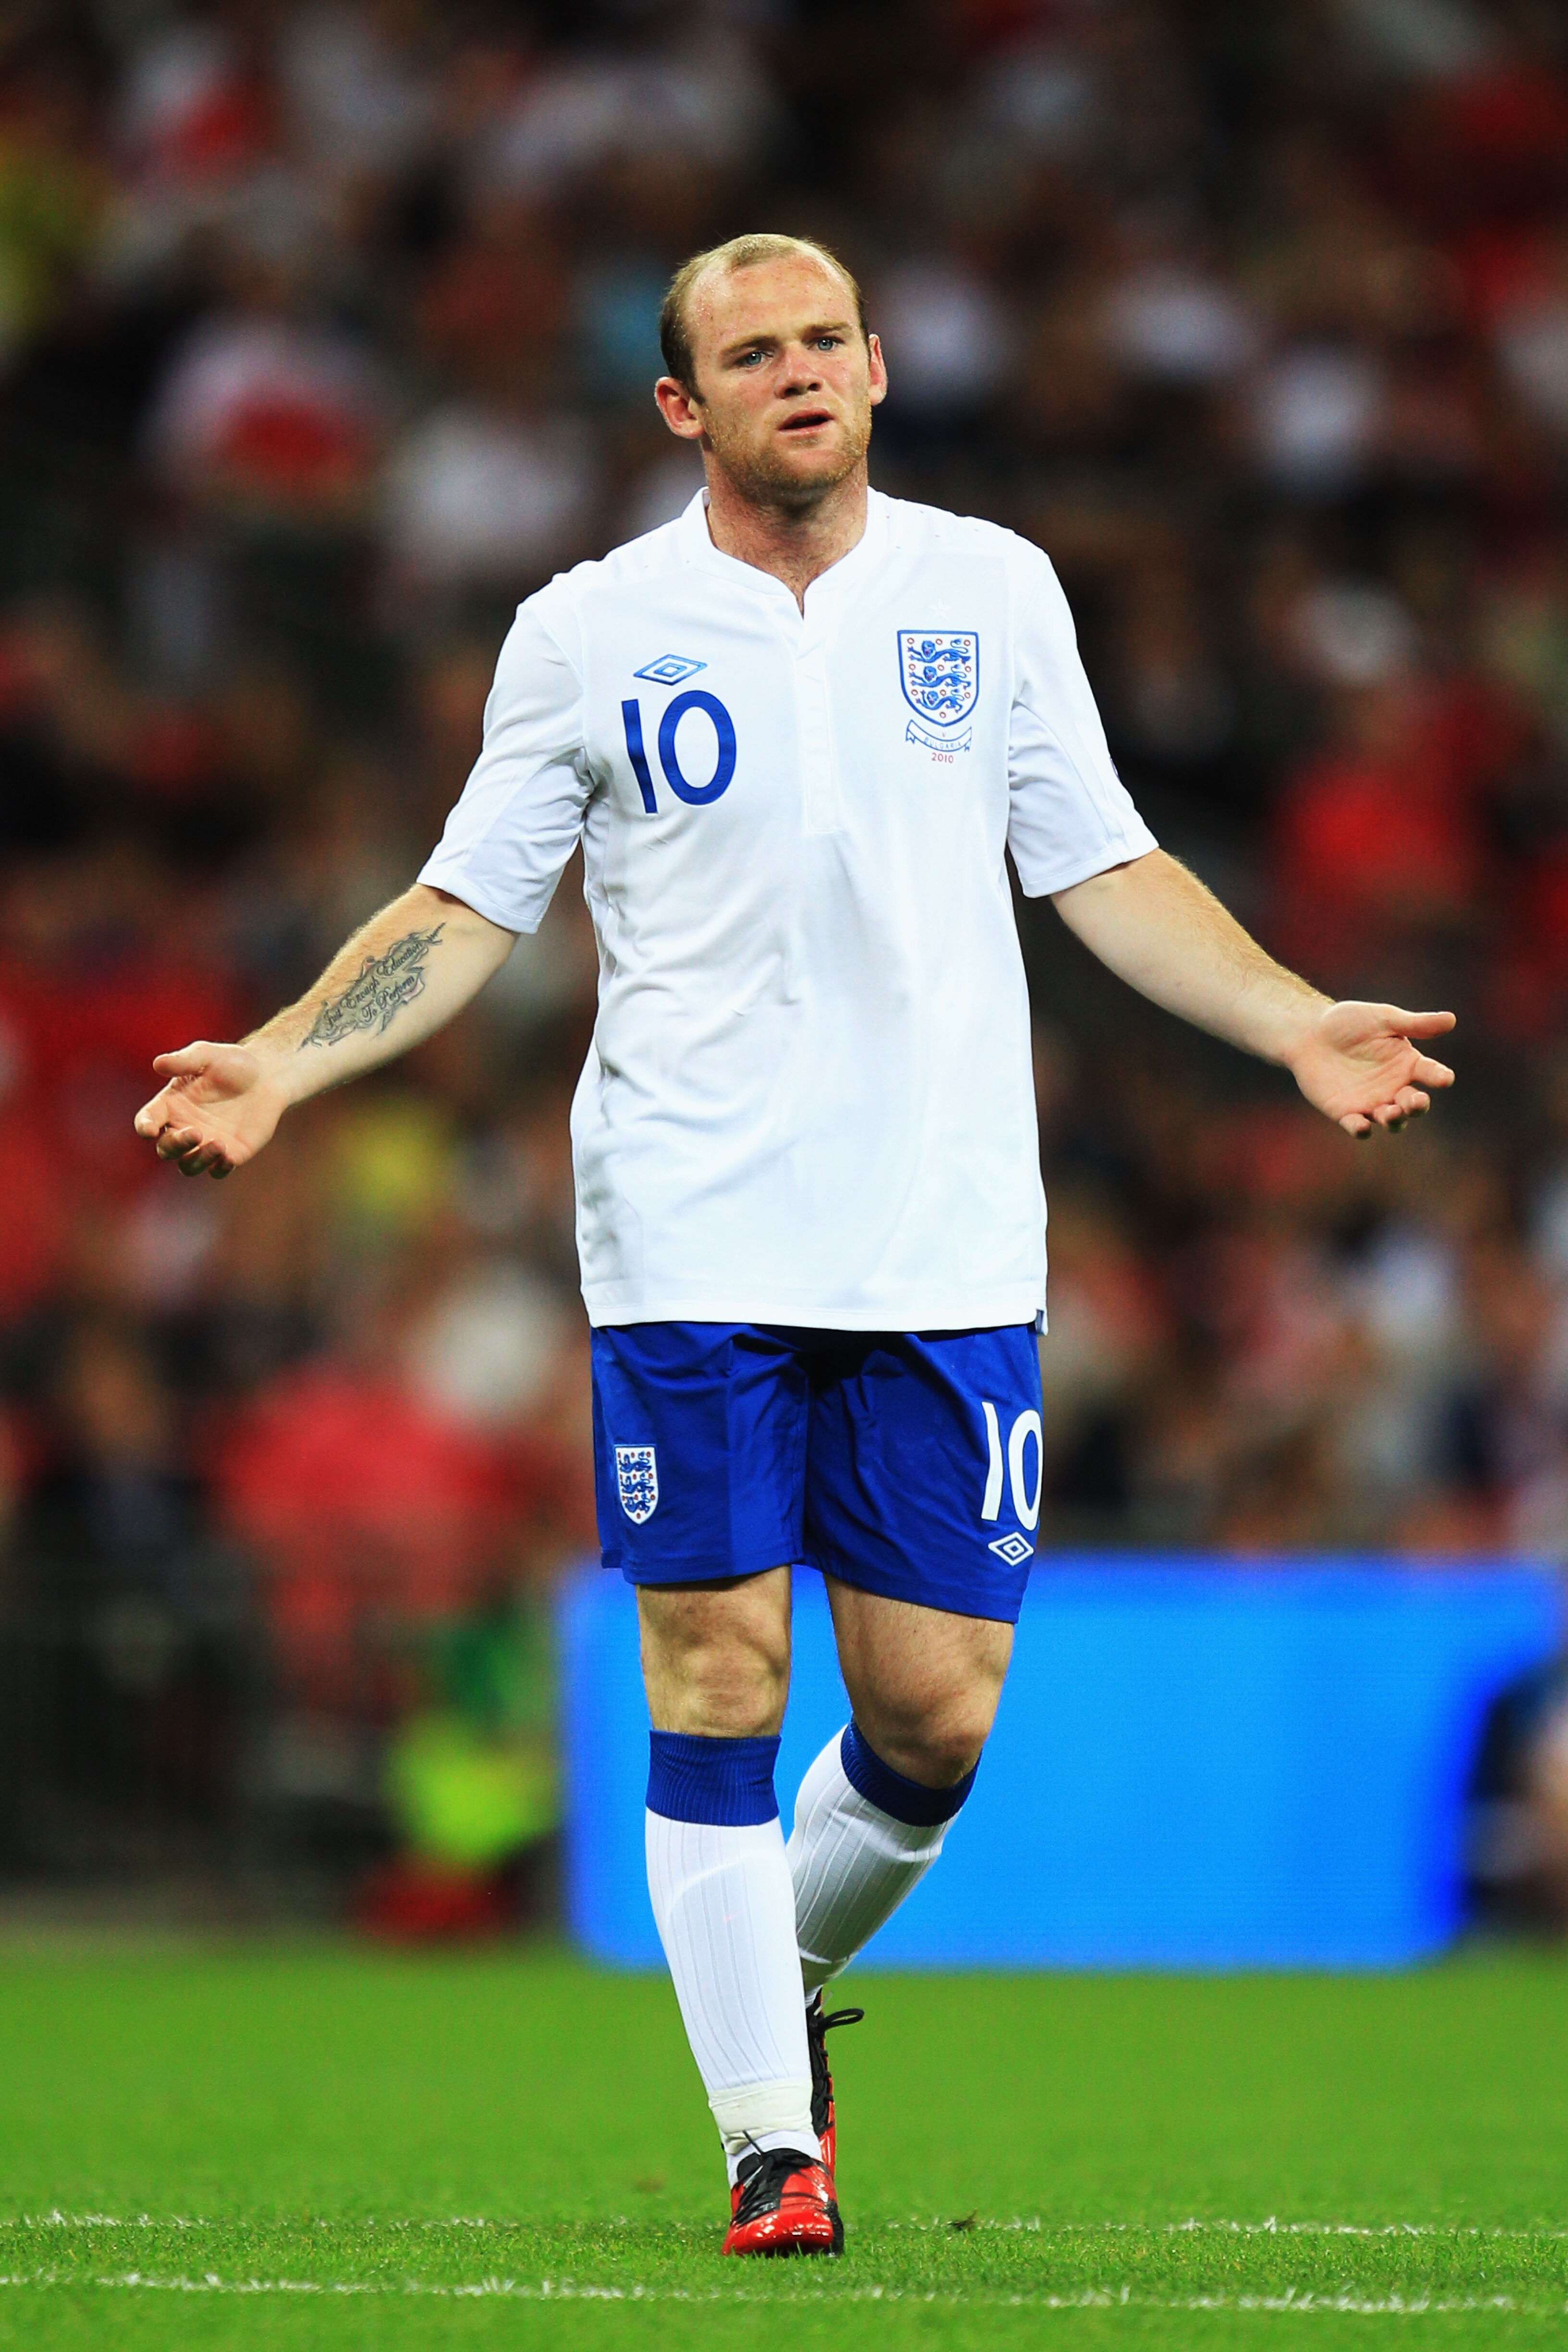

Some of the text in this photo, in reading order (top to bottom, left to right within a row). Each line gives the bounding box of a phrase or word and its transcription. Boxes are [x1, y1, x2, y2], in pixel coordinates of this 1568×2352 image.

[622, 690, 736, 814] 10
[924, 736, 962, 750] BULGARIA
[931, 752, 954, 764] 2010
[340, 976, 380, 1009] Enough
[377, 941, 422, 976] Education
[361, 975, 415, 1022] To Perform
[981, 1401, 1043, 1531] 10
